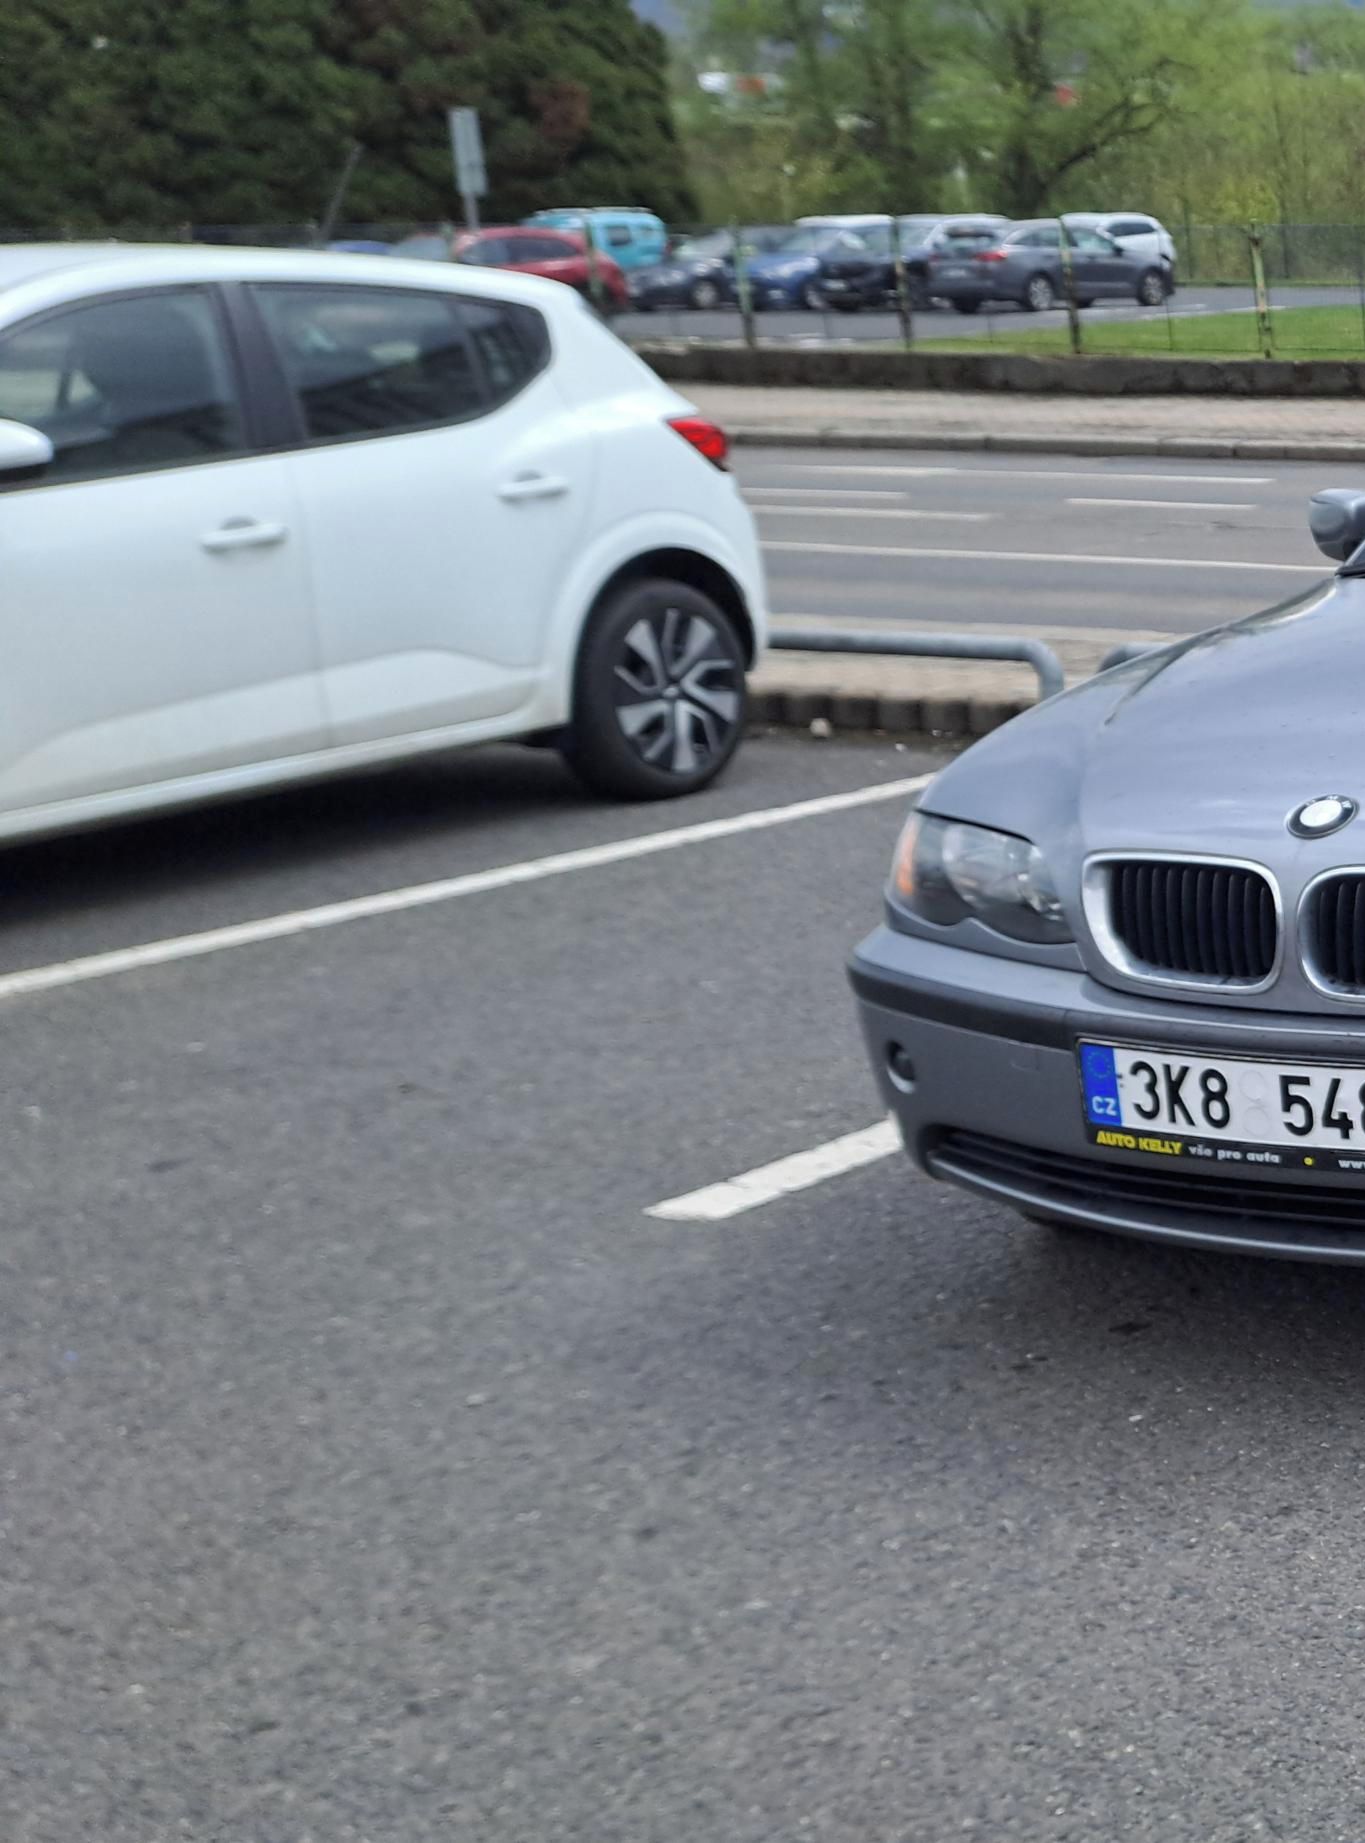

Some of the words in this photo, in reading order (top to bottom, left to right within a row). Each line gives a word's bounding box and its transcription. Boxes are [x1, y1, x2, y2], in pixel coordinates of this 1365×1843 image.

[1091, 1095, 1117, 1116] CZ
[1129, 1060, 1231, 1129] 3K8
[1096, 1130, 1136, 1149] AUTO
[1138, 1136, 1183, 1155] KELLY
[1217, 1151, 1243, 1161] pro
[1246, 1151, 1281, 1164] auta
